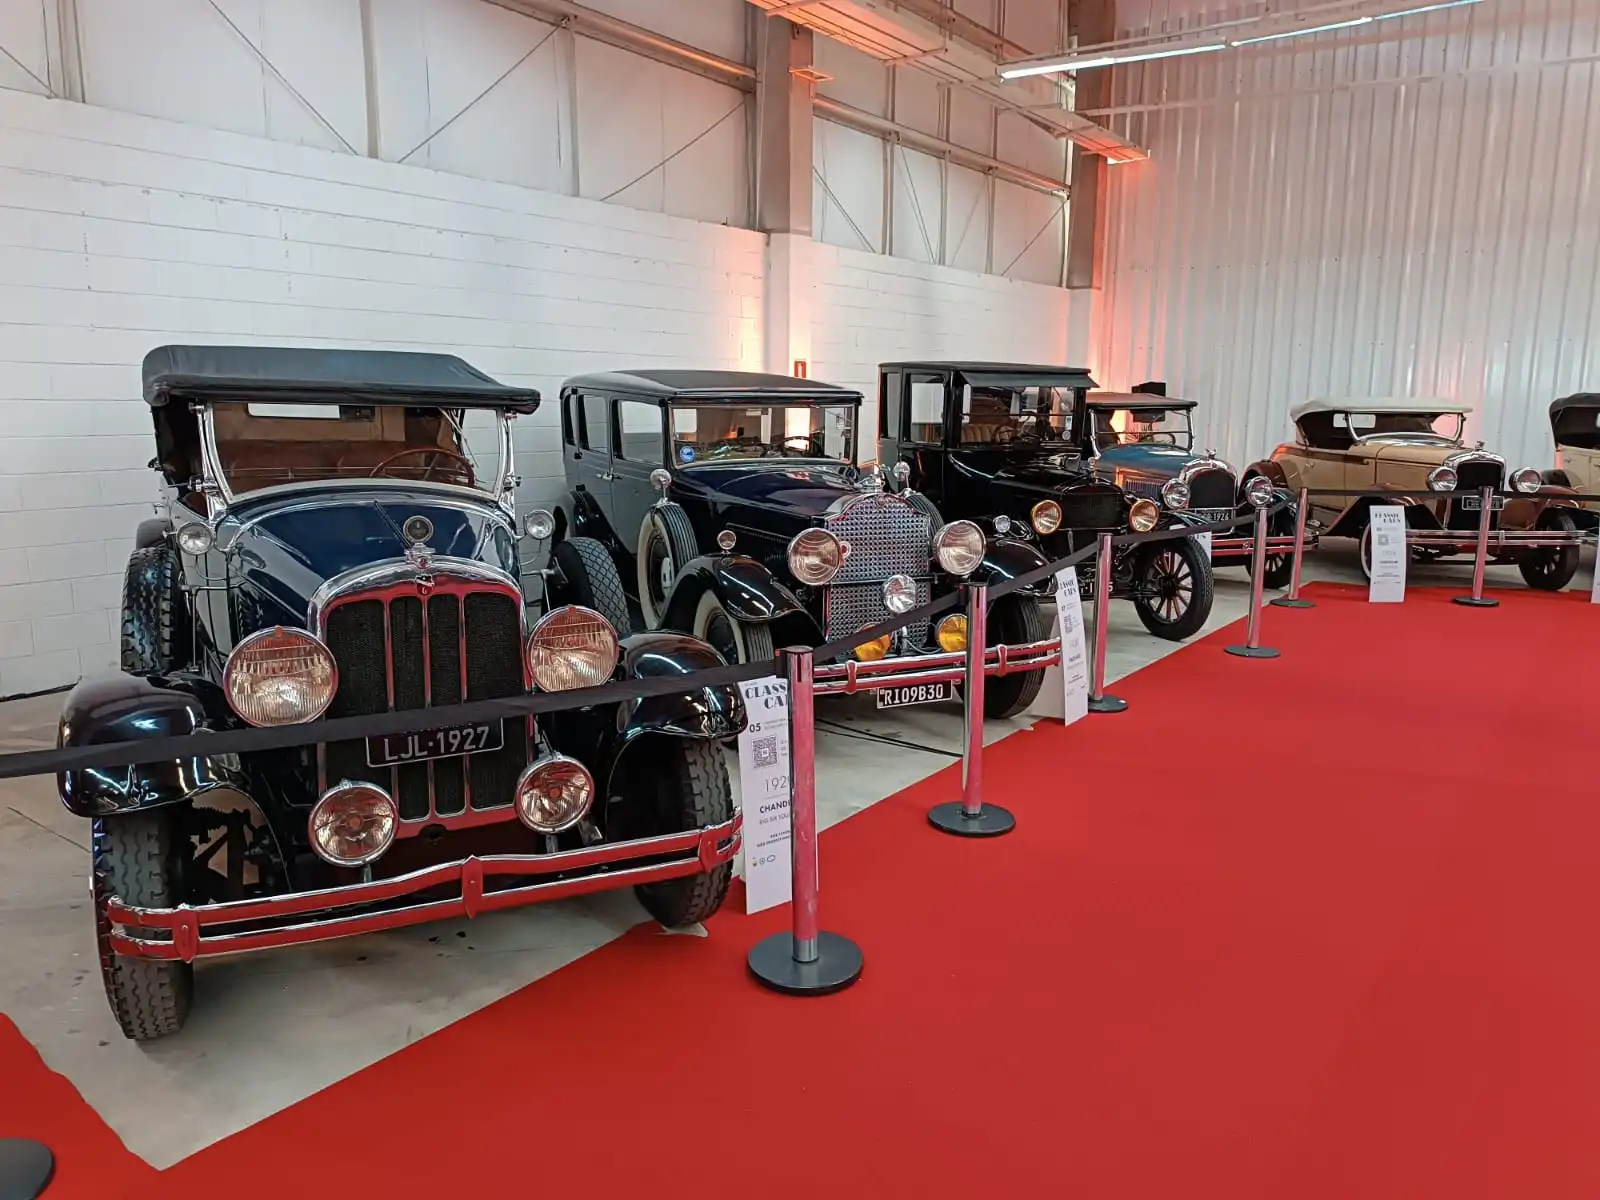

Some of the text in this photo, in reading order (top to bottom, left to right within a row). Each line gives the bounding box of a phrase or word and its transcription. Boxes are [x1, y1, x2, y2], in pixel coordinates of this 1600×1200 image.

[744, 681, 787, 699] CLASS
[764, 694, 788, 710] CA
[749, 722, 761, 733] 05
[759, 800, 792, 814] CHAND
